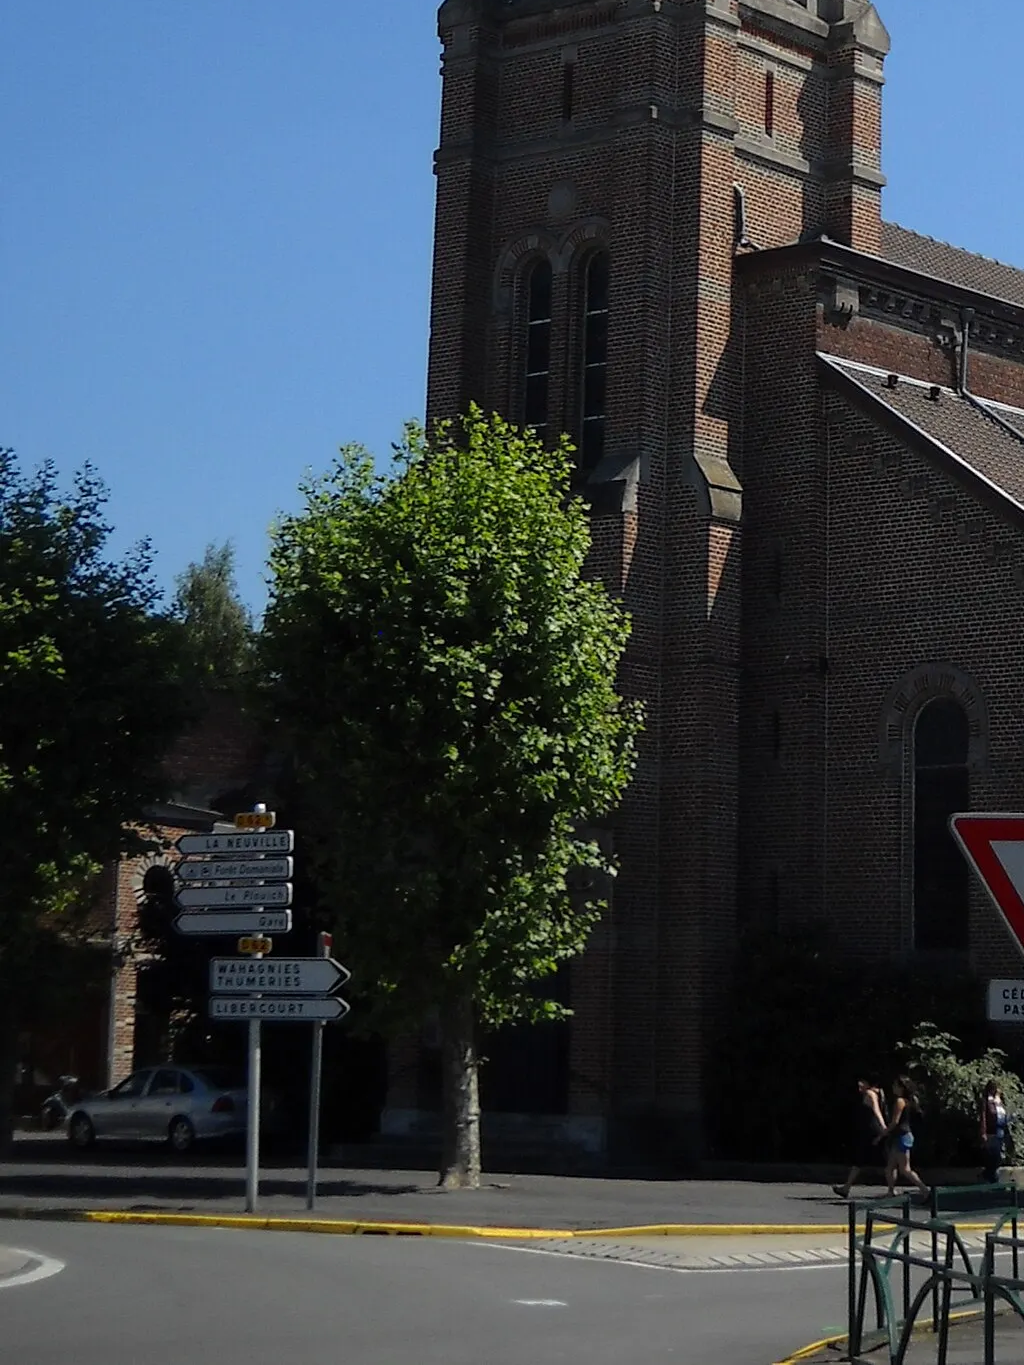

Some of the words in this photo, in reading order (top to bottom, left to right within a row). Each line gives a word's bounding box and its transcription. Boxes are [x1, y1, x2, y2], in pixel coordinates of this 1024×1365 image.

[205, 838, 219, 849] LA
[227, 836, 287, 848] NEUVILLE
[224, 890, 236, 902] Le
[259, 916, 284, 927] Gare
[218, 963, 301, 975] WAHAGNIES
[217, 976, 301, 987] THUMERIES
[216, 1003, 304, 1014] LIBERCOURT
